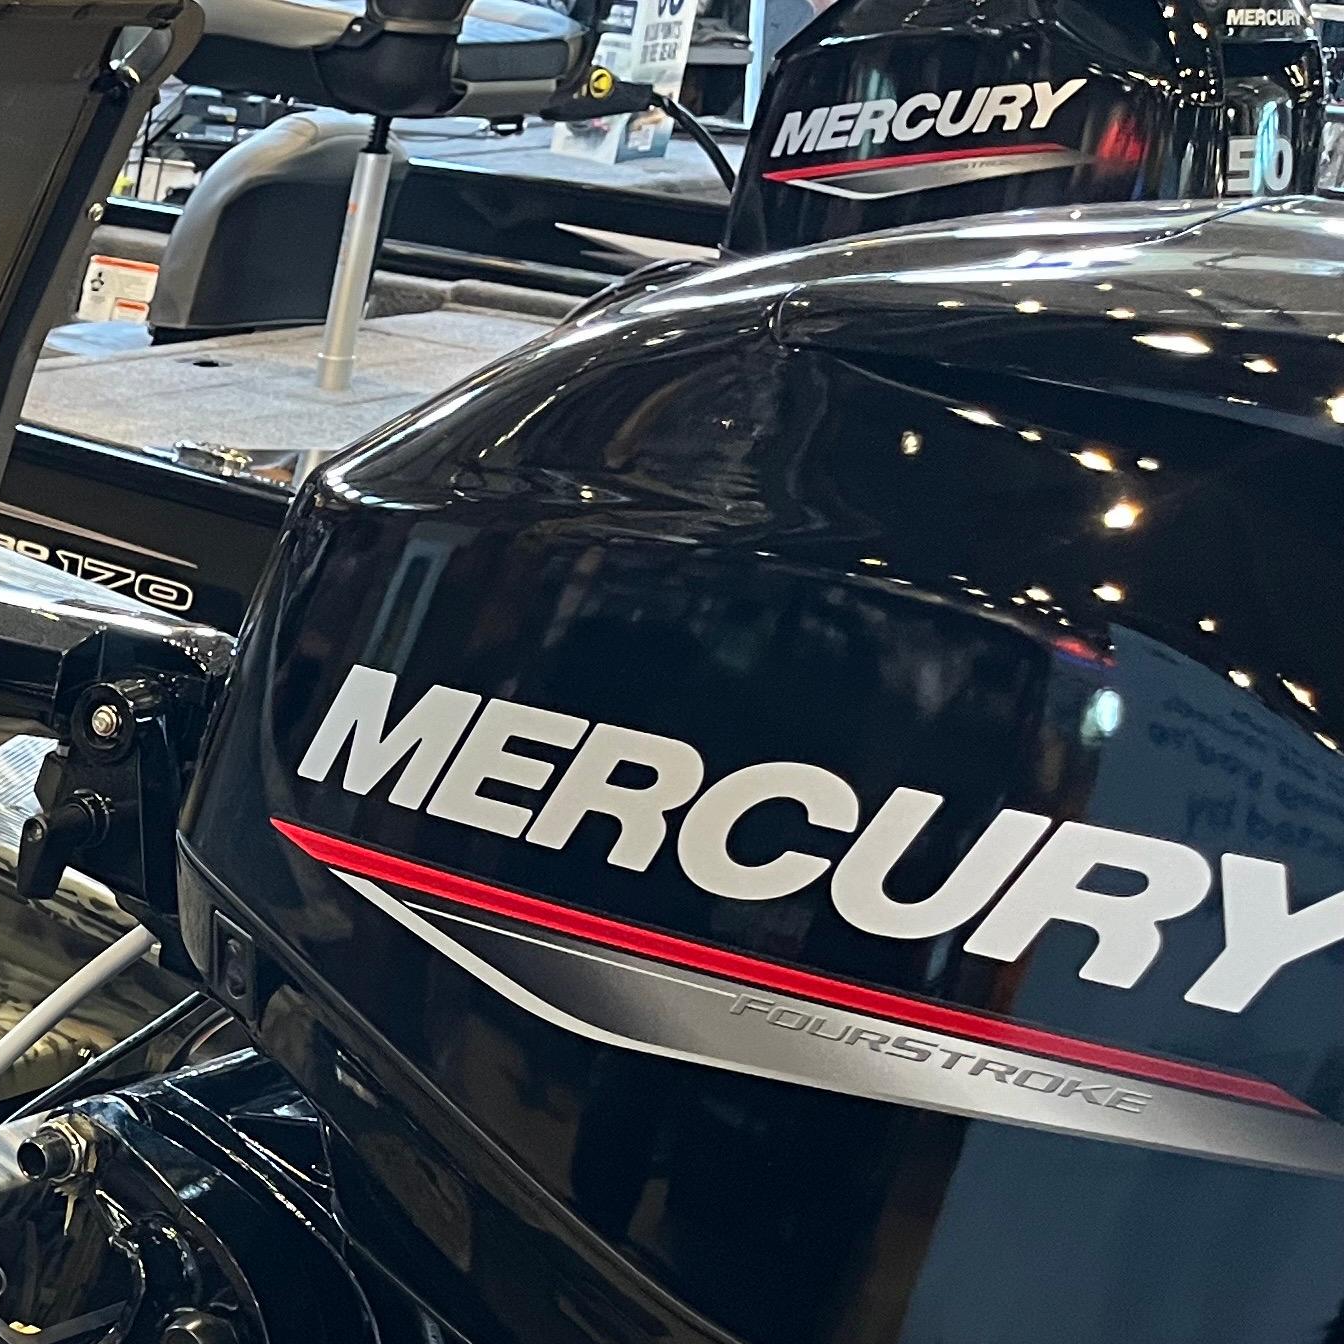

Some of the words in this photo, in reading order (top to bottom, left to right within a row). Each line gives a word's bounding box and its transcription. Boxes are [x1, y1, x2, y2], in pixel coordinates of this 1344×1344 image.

[1226, 8, 1302, 26] MERCURY
[770, 79, 1088, 158] MERCURY
[1226, 135, 1294, 195] 50
[297, 664, 1344, 1012] MERCURY
[729, 993, 1153, 1116] FOURSTROKE
